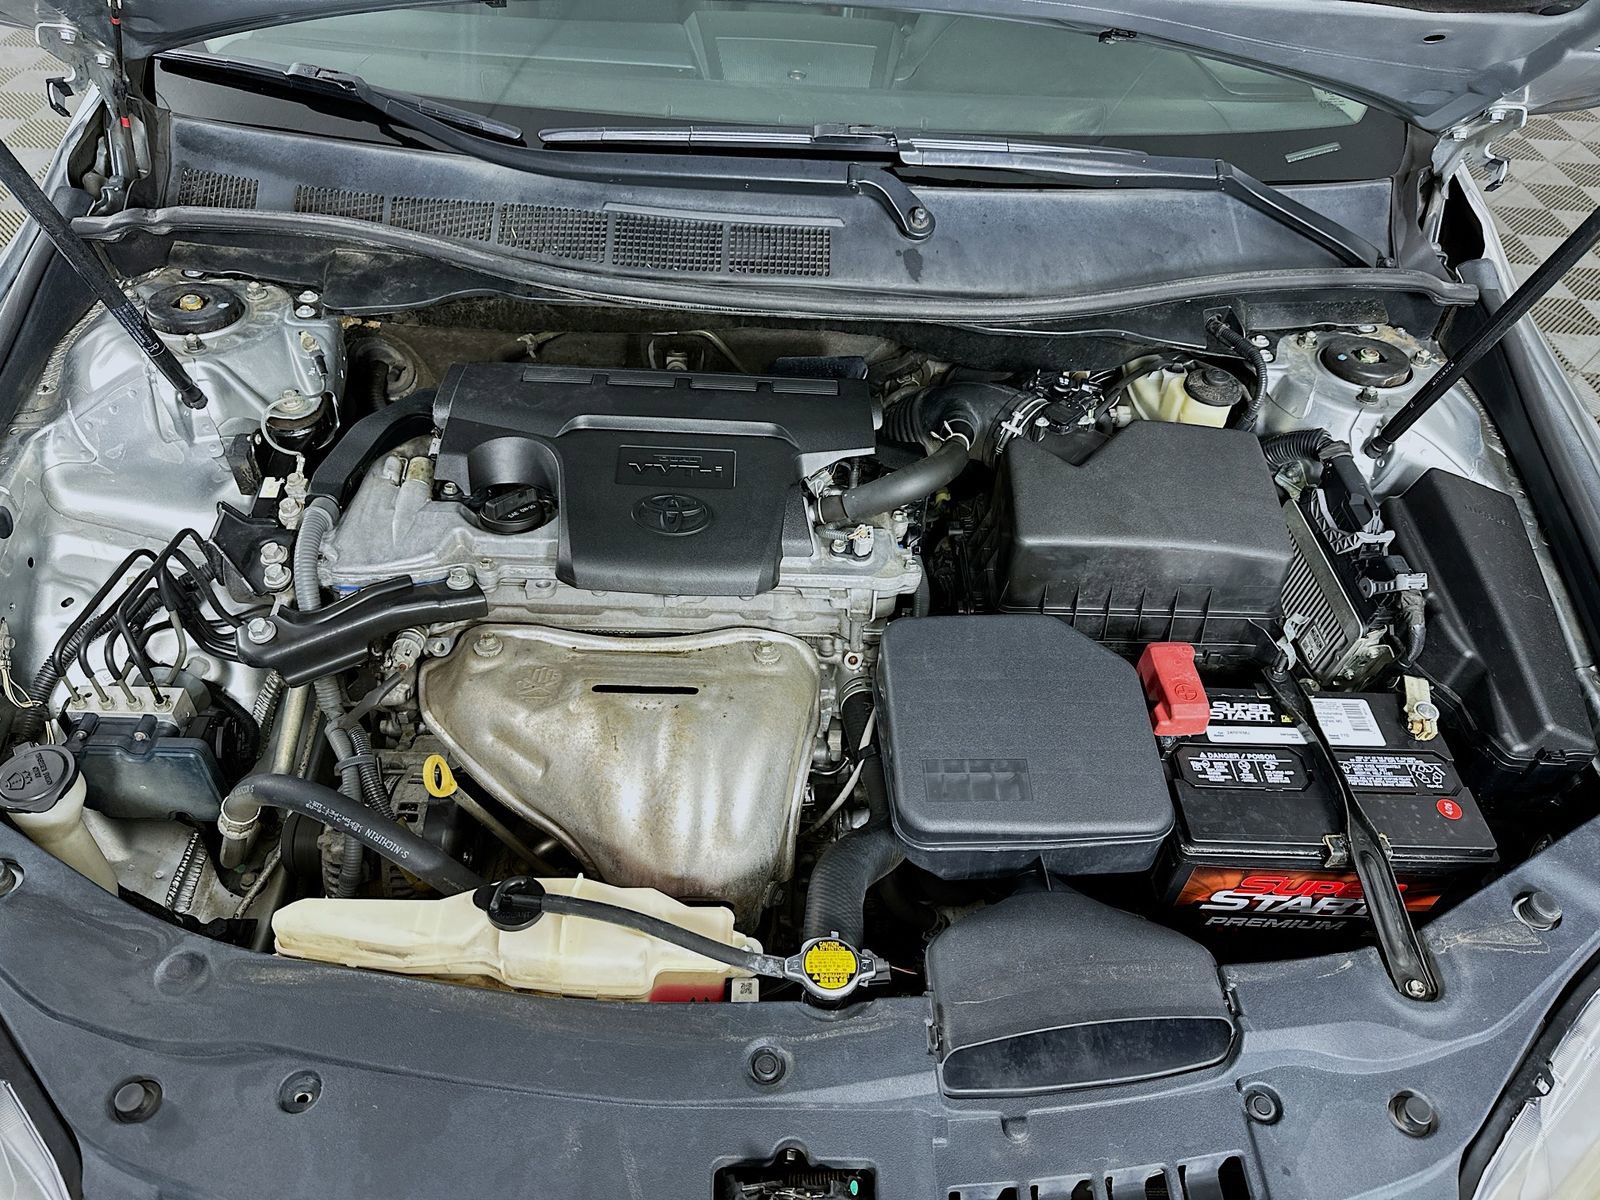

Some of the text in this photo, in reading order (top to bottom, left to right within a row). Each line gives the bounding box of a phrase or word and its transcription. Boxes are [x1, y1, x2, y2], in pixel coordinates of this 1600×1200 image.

[1212, 701, 1272, 713] SUPER
[1209, 710, 1276, 724] START
[1207, 752, 1240, 760] DANGER
[1247, 753, 1277, 761] POISON
[1232, 875, 1409, 898] SUPE
[1204, 916, 1347, 931] PREMIUM
